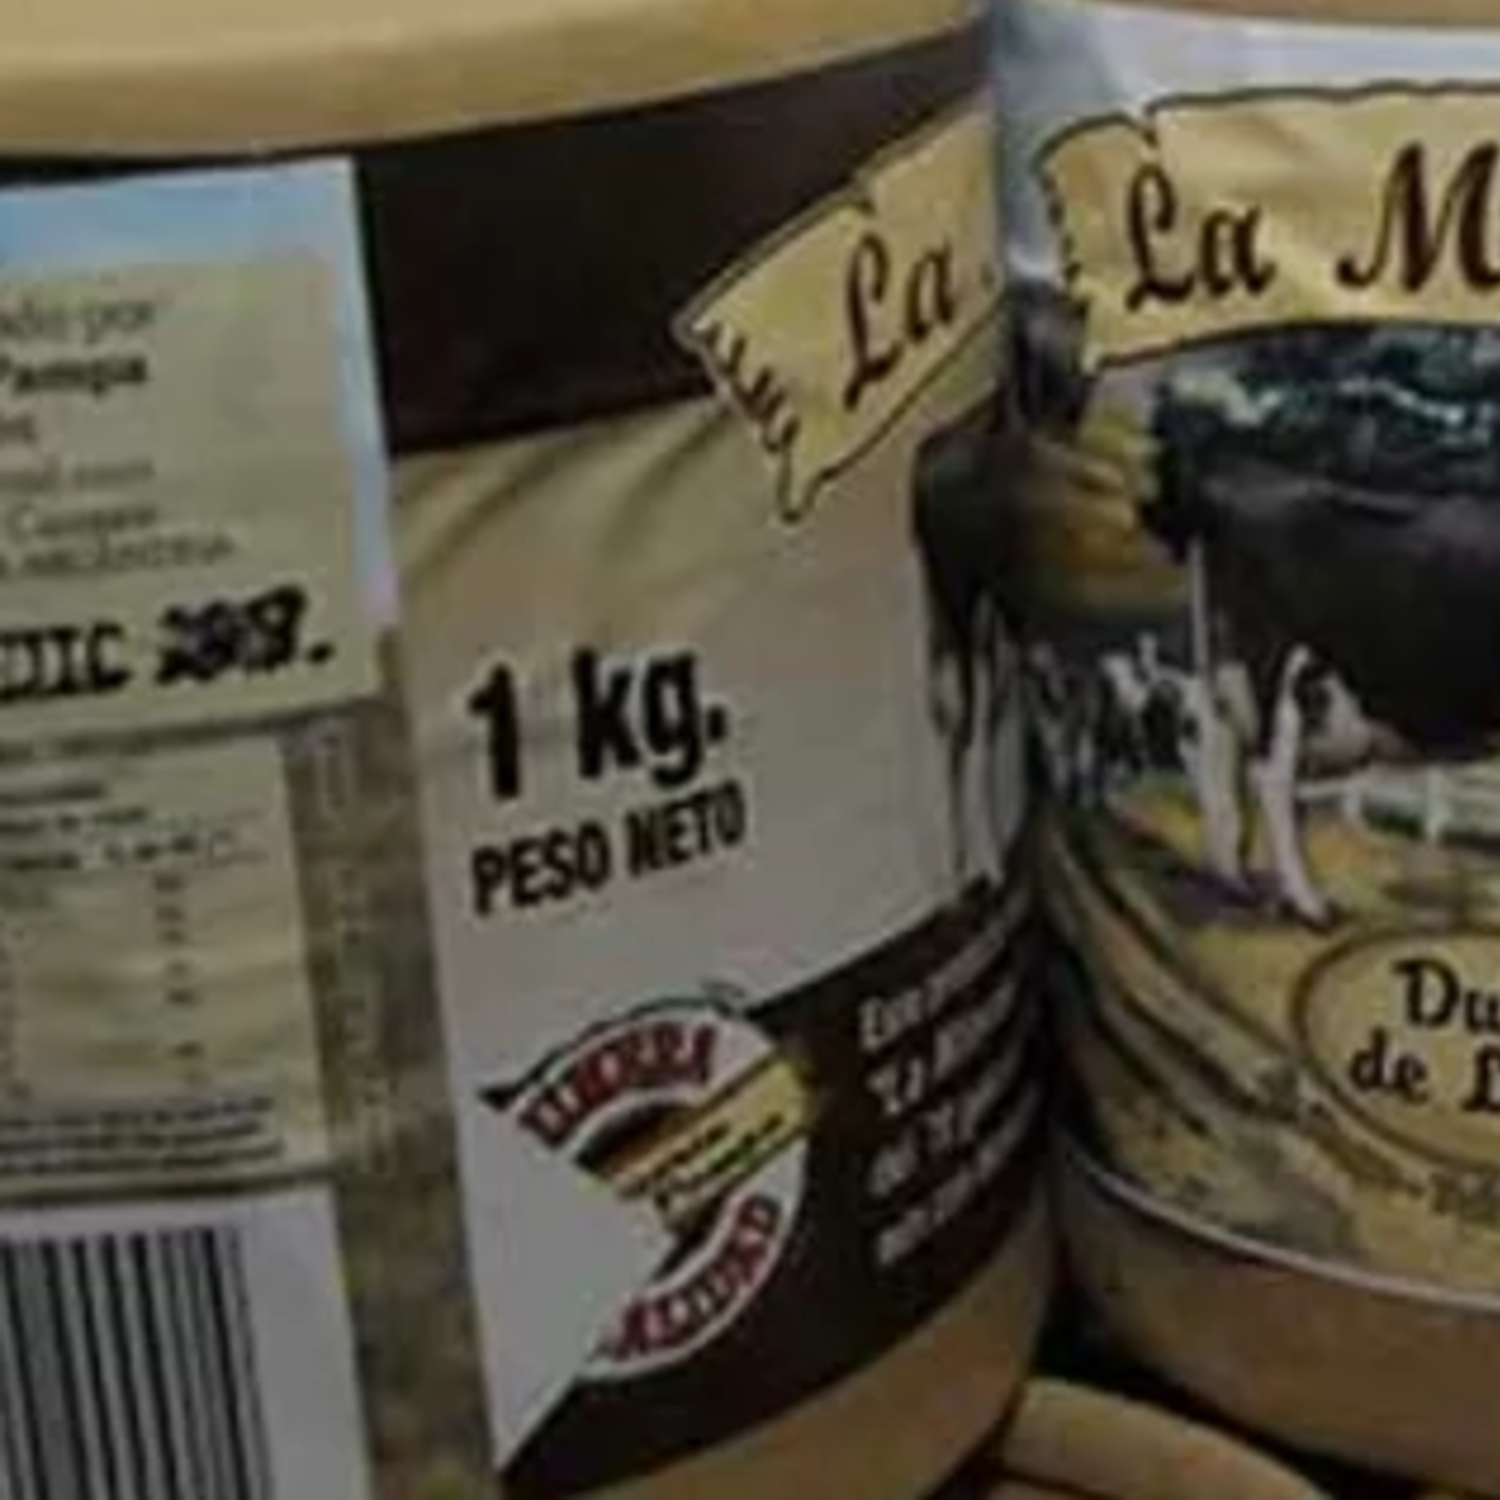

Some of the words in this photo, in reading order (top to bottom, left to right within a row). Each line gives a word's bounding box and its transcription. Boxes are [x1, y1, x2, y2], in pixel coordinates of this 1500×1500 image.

[1124, 160, 1278, 314] La
[843, 230, 957, 412] La
[466, 660, 520, 802] 1
[573, 645, 726, 790] kg.
[472, 818, 612, 916] PESO
[624, 780, 744, 876] NETO
[1350, 1024, 1430, 1104] de
